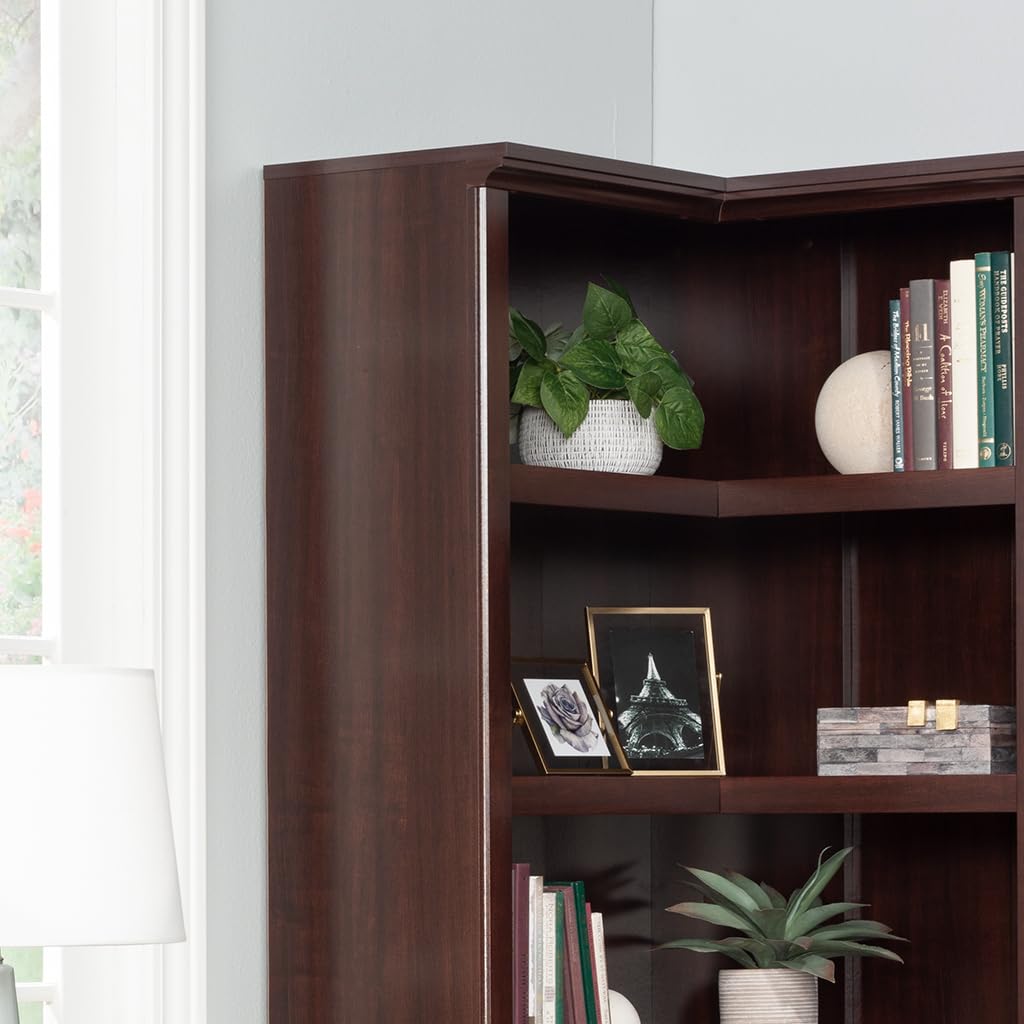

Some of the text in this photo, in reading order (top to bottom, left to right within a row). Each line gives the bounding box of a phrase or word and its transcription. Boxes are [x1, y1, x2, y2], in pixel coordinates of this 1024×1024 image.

[1000, 286, 1008, 334] GUIDEPOSTS
[939, 334, 951, 342] A
[980, 327, 988, 373] PHARMACY
[939, 345, 952, 383] Coalition
[893, 375, 902, 397] County
[940, 386, 952, 396] of
